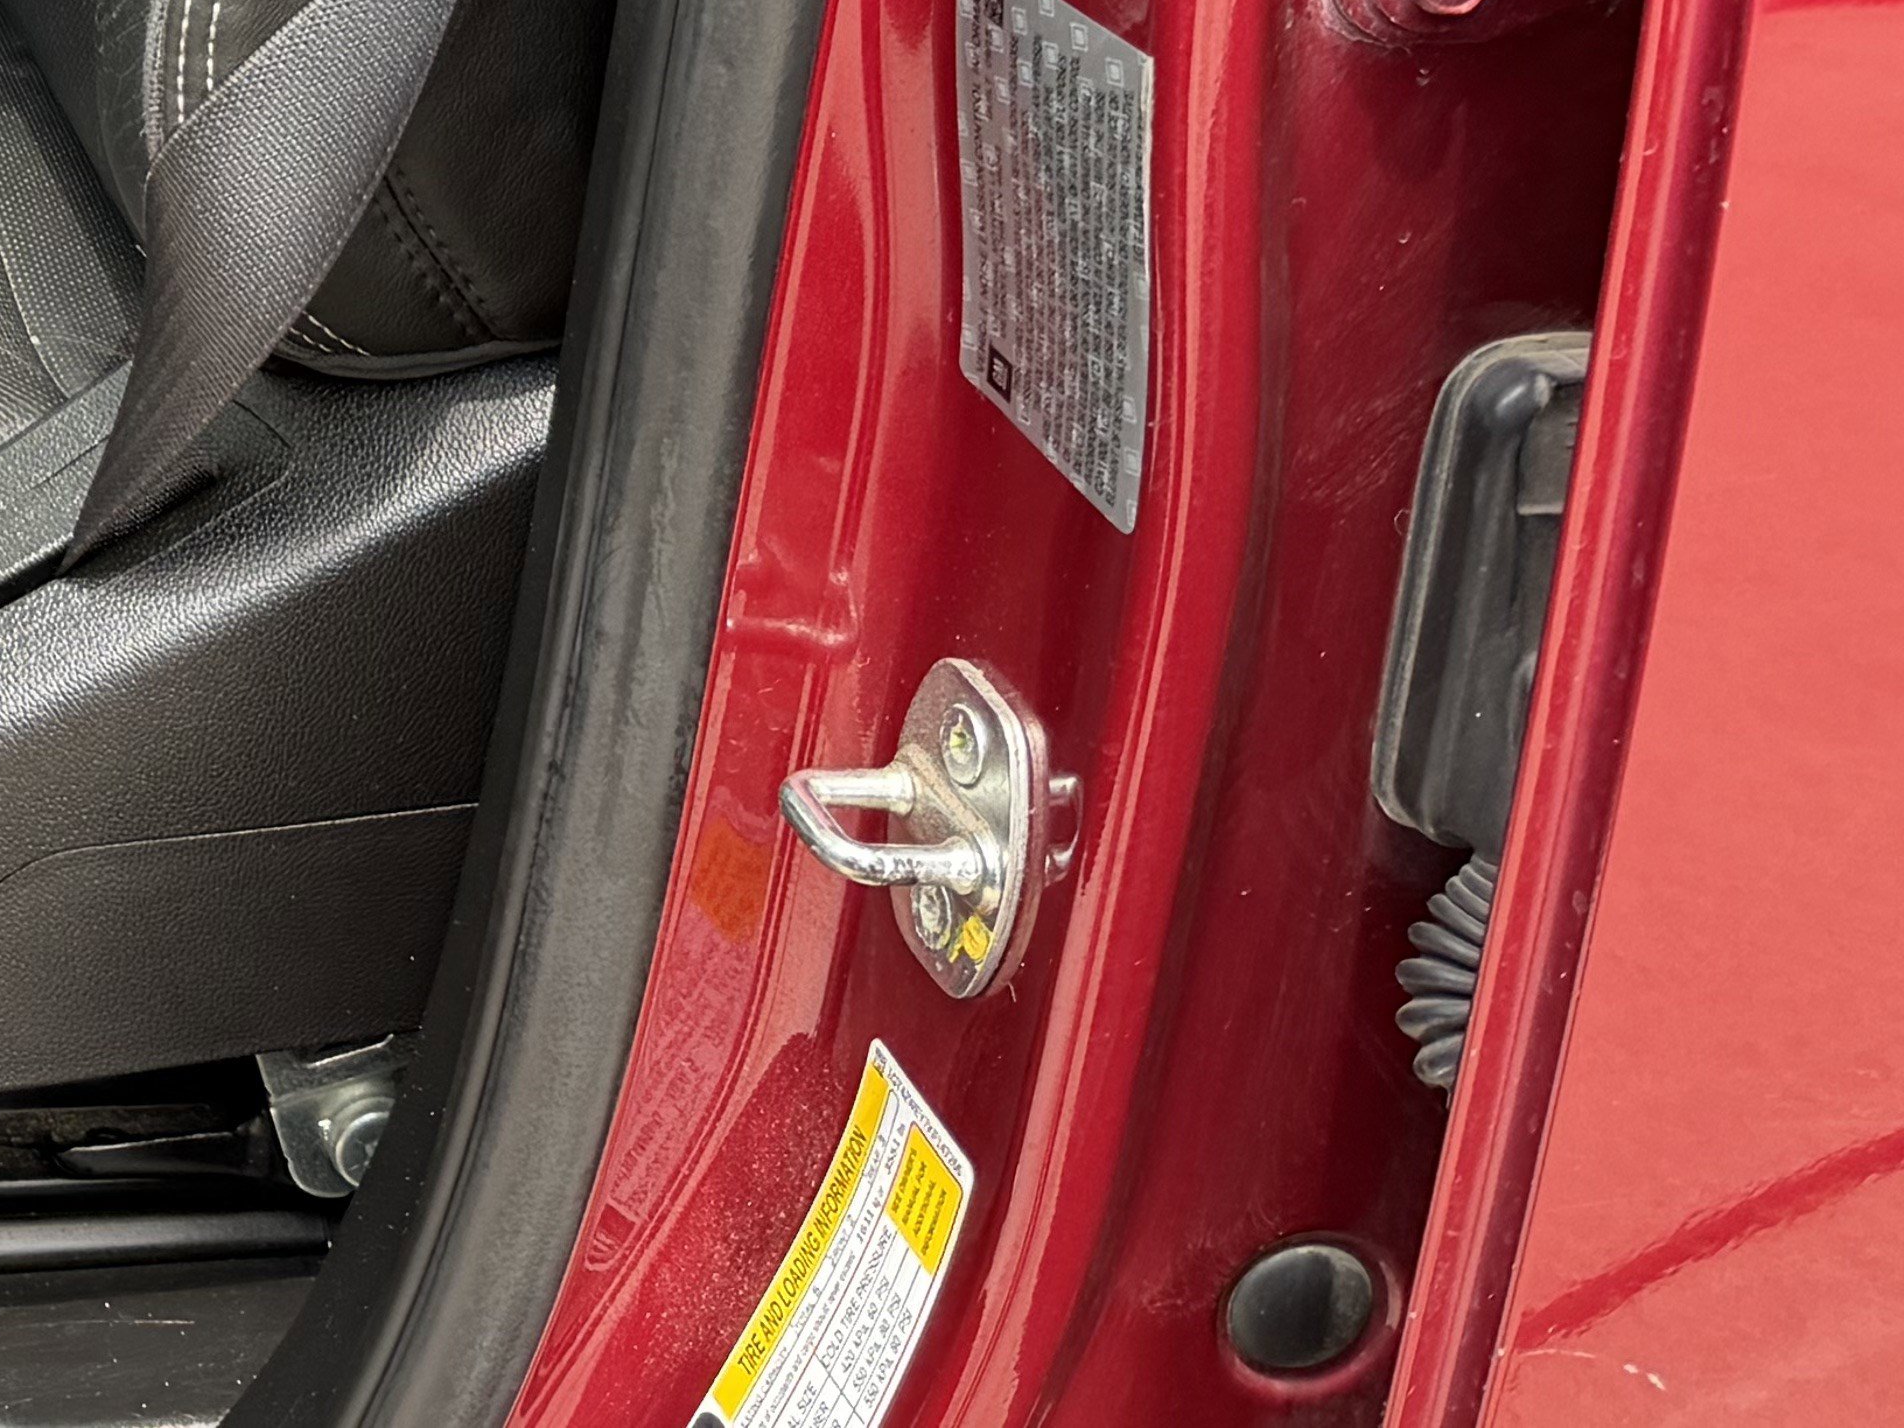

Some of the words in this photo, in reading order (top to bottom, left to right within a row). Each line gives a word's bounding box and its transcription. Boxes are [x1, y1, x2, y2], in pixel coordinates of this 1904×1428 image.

[737, 1331, 767, 1375] TIRE
[762, 1300, 785, 1340] AND
[782, 1231, 821, 1307] LOADING
[817, 1124, 869, 1240] INFORMATION
[816, 1328, 843, 1370] COLD
[840, 1298, 860, 1334] TIRE
[855, 1224, 893, 1301] PRESSURE
